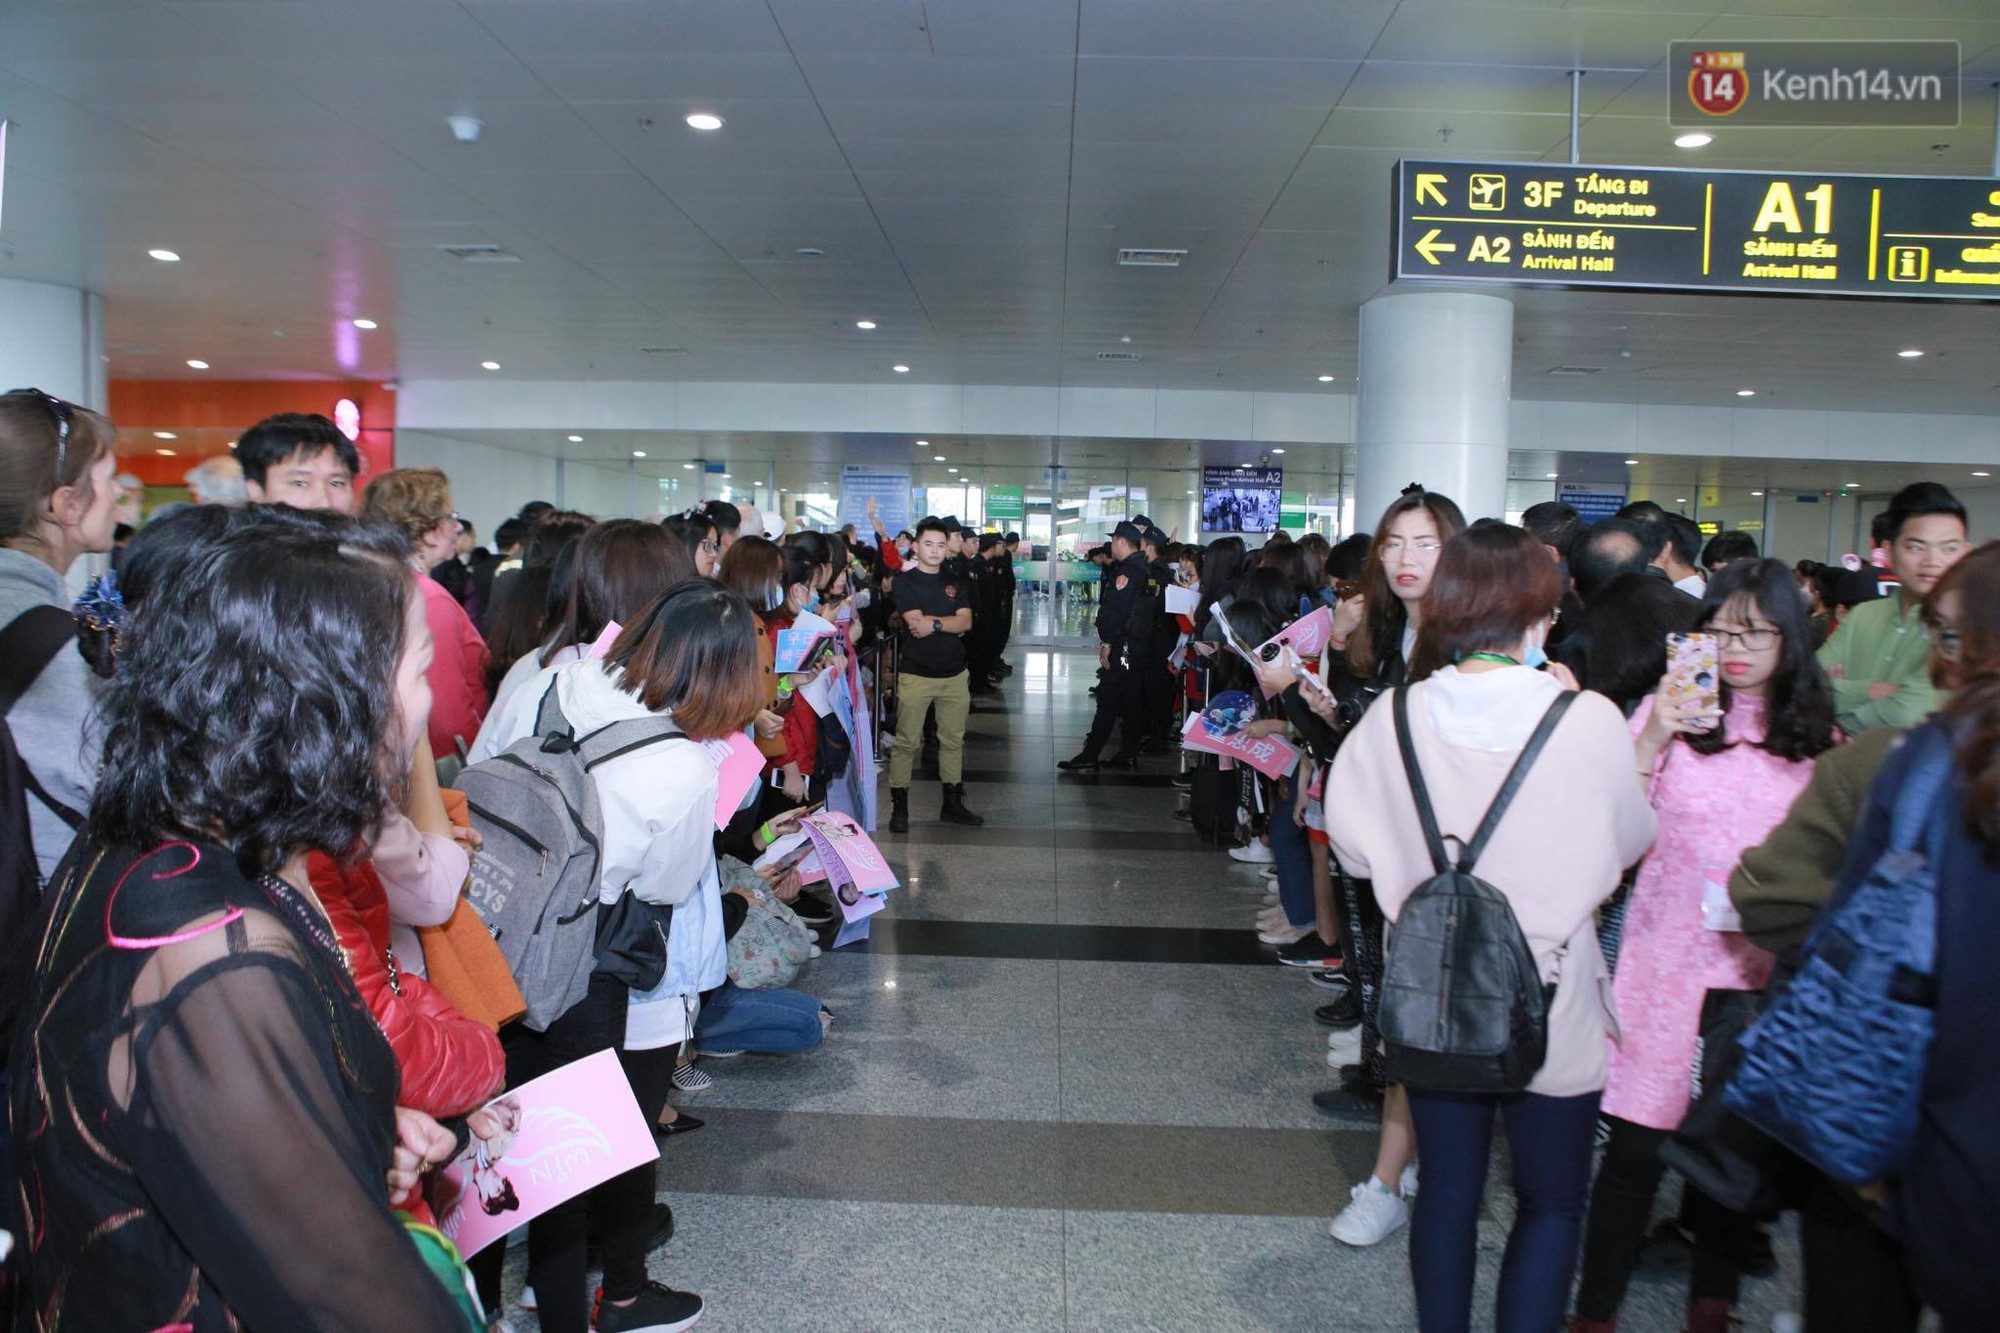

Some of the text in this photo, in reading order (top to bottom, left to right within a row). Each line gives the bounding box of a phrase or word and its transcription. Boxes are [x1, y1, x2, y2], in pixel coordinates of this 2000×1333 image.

[1523, 181, 1564, 208] 3F
[1629, 179, 1649, 195] ĐI
[1574, 199, 1656, 218] Departure
[1752, 182, 1833, 233] A1
[1522, 227, 1572, 249] SẢNH
[1467, 235, 1511, 263] A2
[1522, 254, 1614, 272] Arrival Hall
[1742, 262, 1837, 279] Arrival Hall
[1265, 471, 1281, 483] A2
